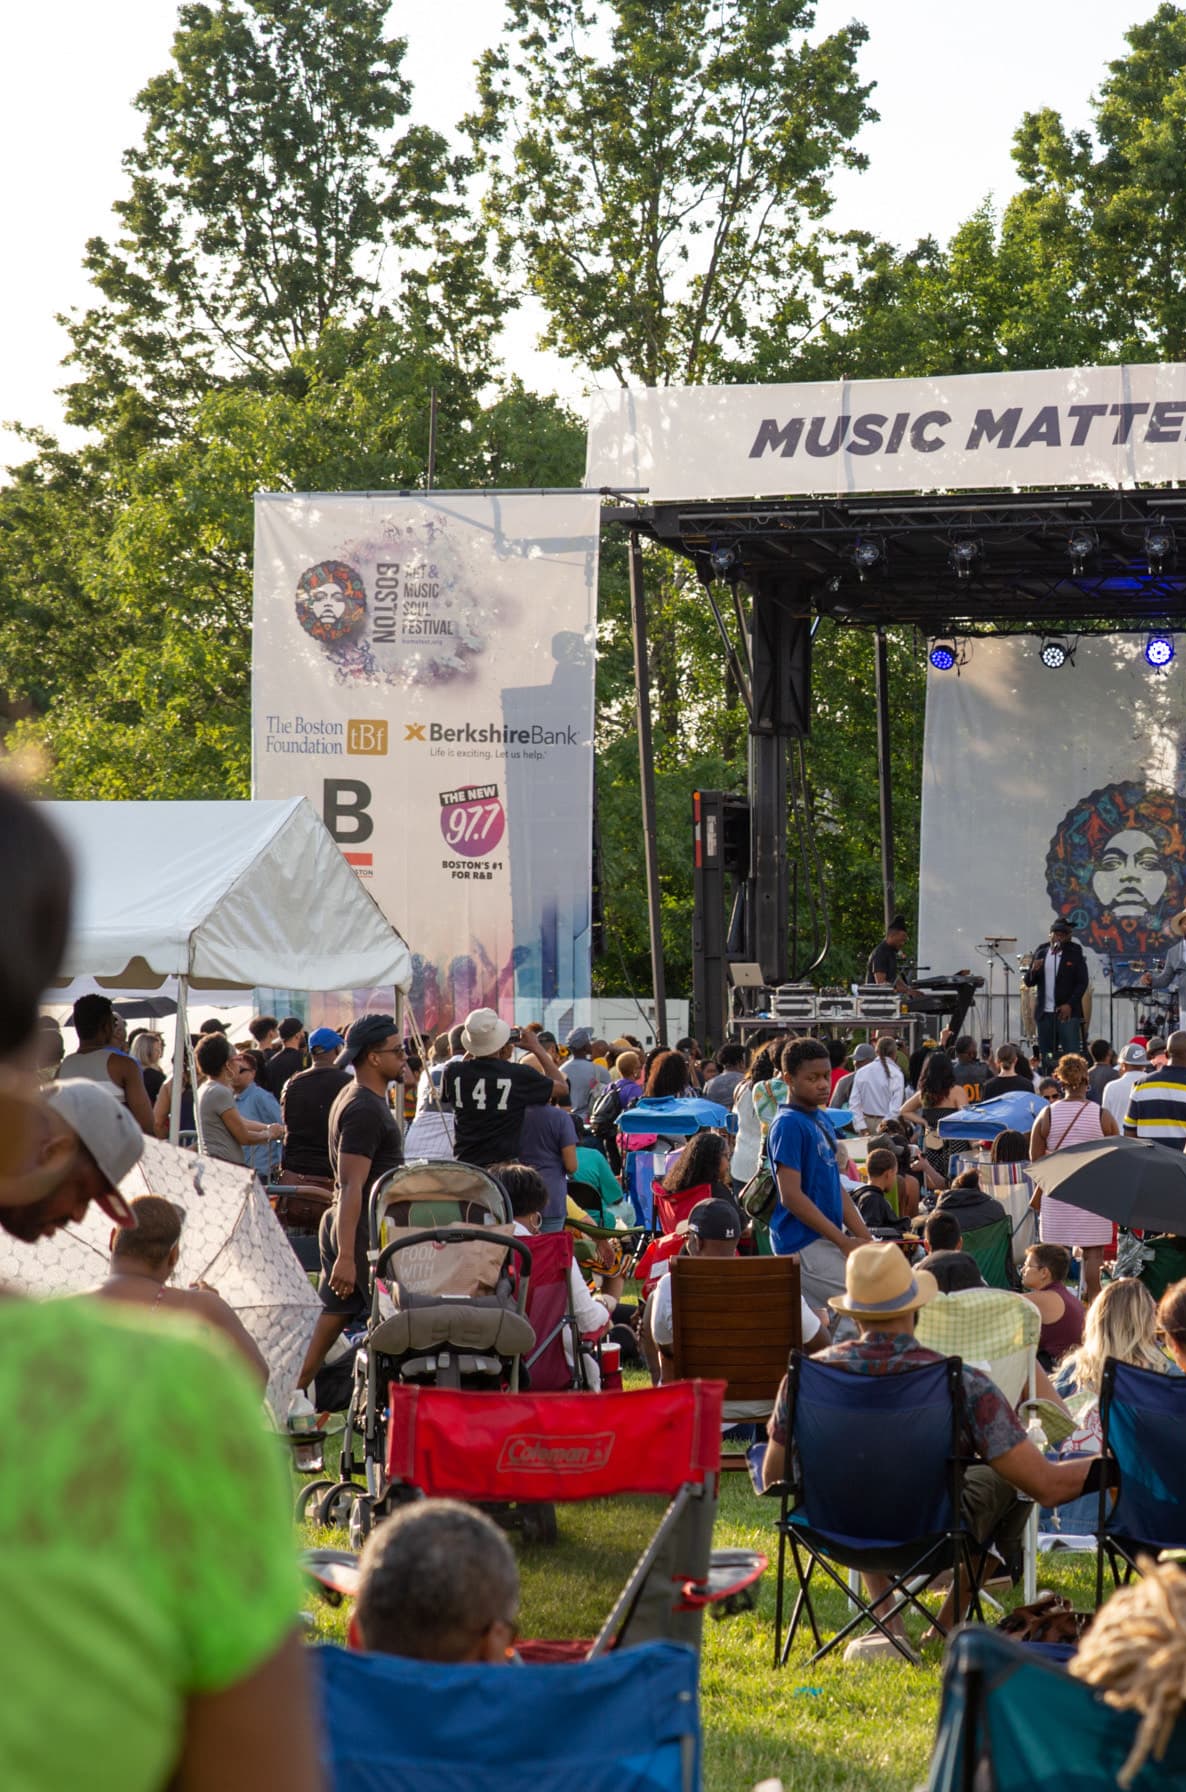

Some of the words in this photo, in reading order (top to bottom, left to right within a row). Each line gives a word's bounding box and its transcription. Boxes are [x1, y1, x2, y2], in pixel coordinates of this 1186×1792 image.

[749, 410, 952, 458] MUSIC
[428, 564, 440, 579] &
[403, 582, 440, 599] MUSIC
[372, 563, 400, 643] BOSTON
[402, 601, 431, 617] SOUL
[401, 619, 454, 636] FESTIVAL
[266, 716, 292, 735] The
[295, 716, 344, 735] Boston
[429, 723, 578, 746] BerkshireBank
[266, 736, 344, 754] Foundation
[350, 723, 385, 751] tBf
[430, 748, 446, 757] Life
[447, 748, 455, 757] is
[456, 748, 493, 760] exciting.
[495, 749, 508, 759] Let
[510, 751, 520, 759] us
[441, 792, 466, 805] THE
[467, 785, 497, 801] NEW
[323, 778, 374, 844] B
[446, 802, 501, 844] 97.7
[442, 860, 490, 870] BOSTON'S
[492, 861, 503, 870] #1
[451, 871, 471, 880] FOR
[473, 871, 493, 880] R&B
[401, 1246, 437, 1260] FOOD
[399, 1262, 434, 1278] WITH
[508, 1439, 590, 1464] Coleman
